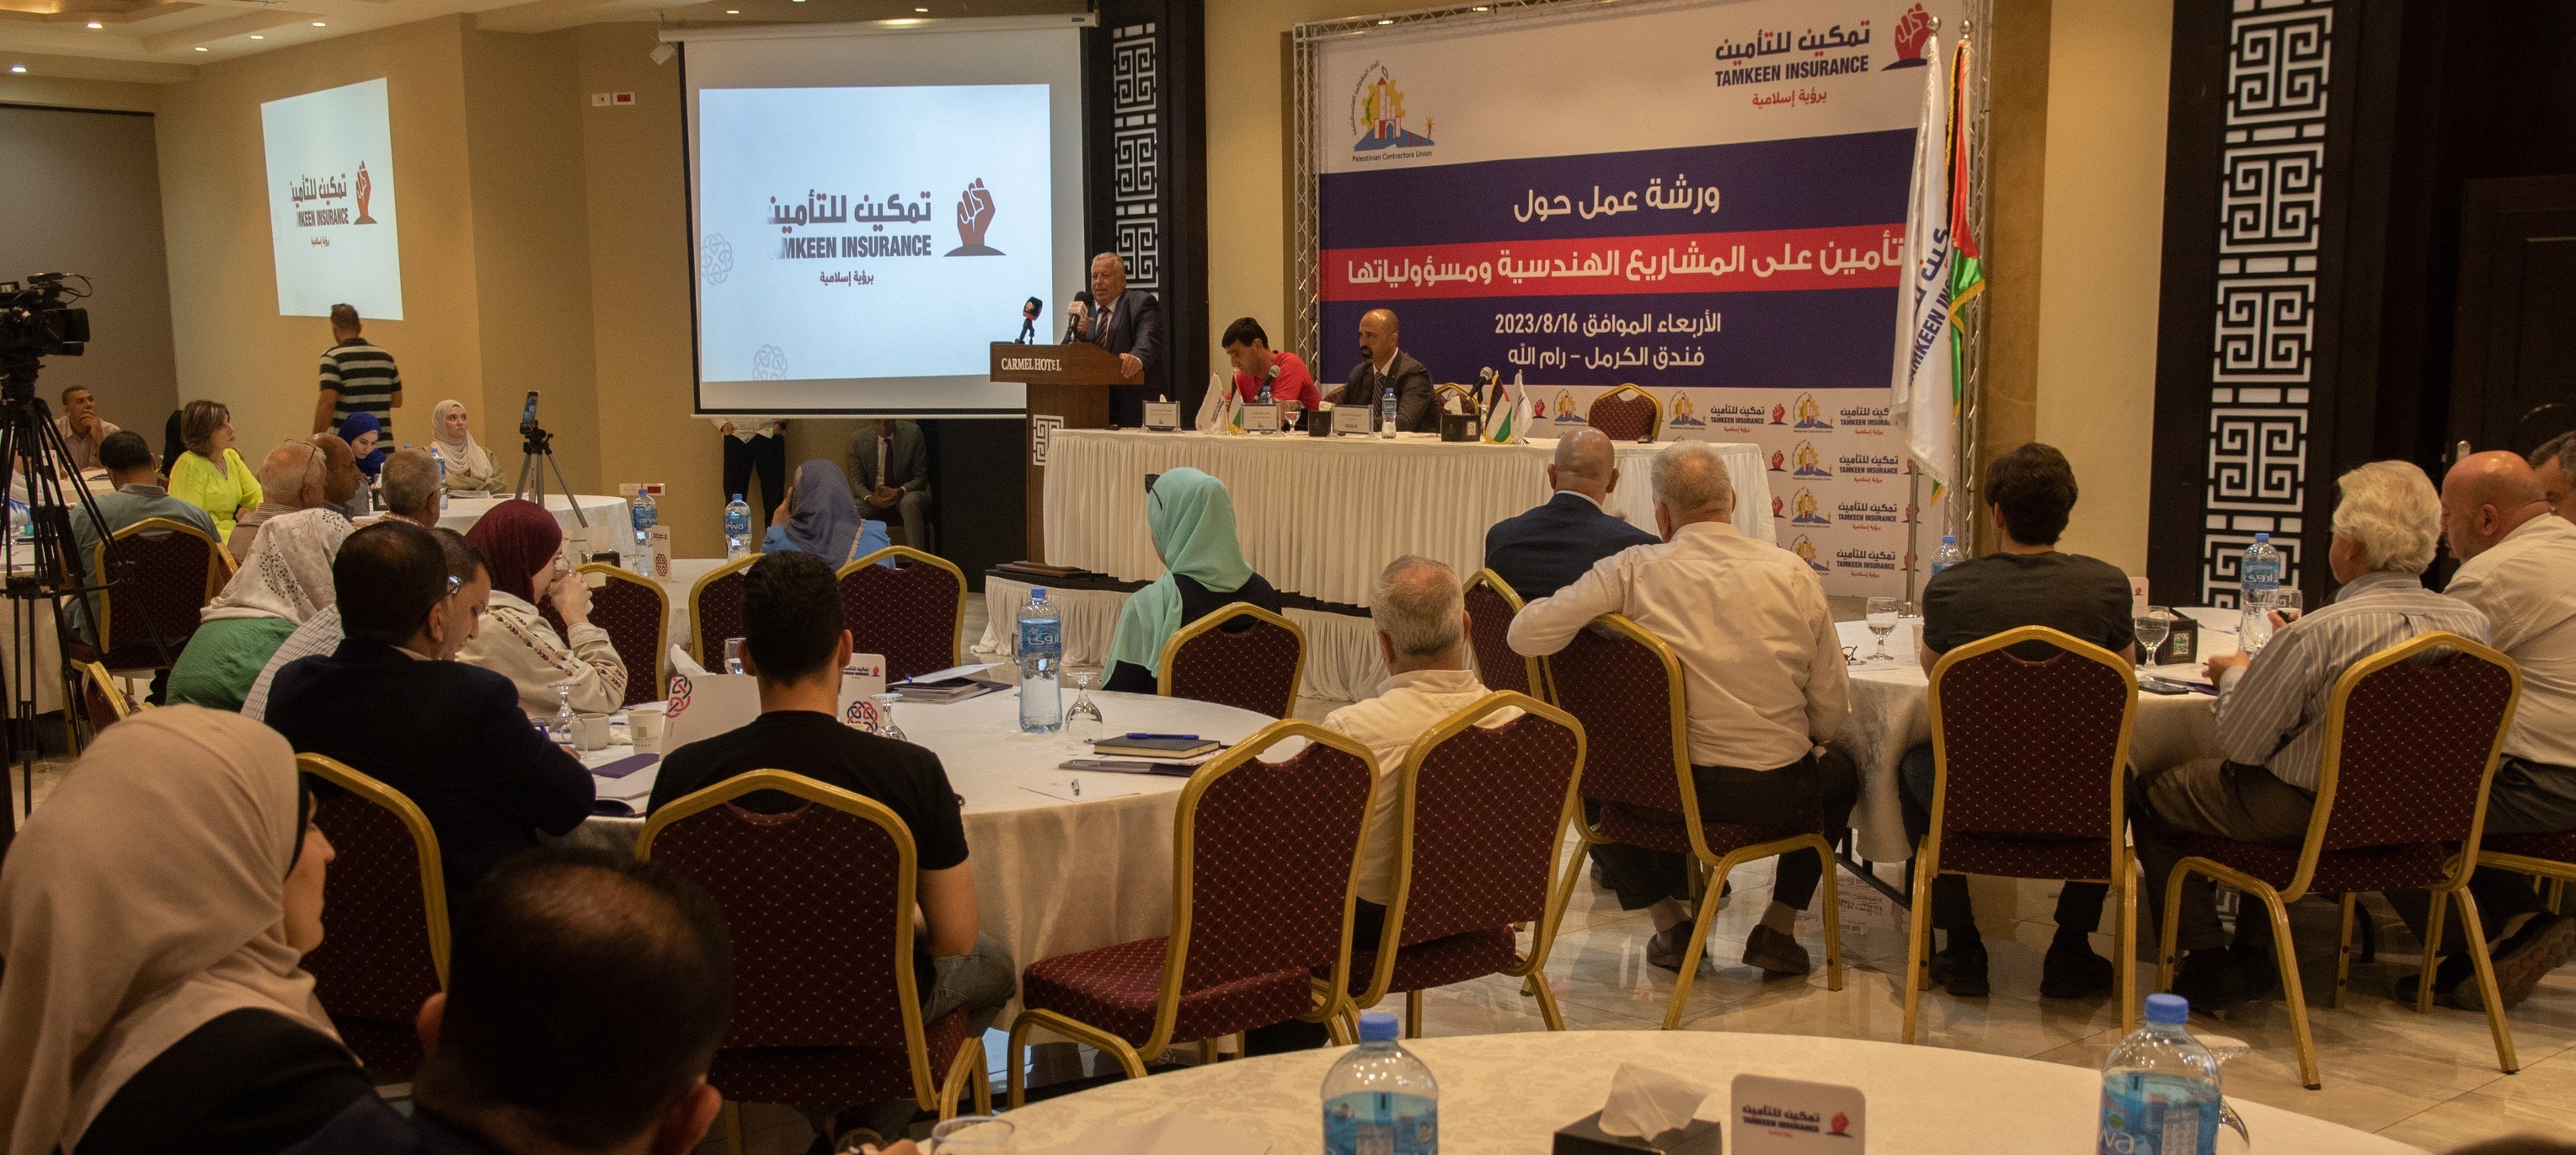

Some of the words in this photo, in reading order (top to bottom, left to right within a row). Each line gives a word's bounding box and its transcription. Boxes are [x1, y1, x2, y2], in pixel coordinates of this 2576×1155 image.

[1715, 29, 1792, 66] للتأمين
[1798, 20, 1870, 56] تمكين
[1715, 64, 1781, 87] TAMKEEN
[1786, 55, 1869, 80] INSURANCE
[1752, 89, 1795, 109] إسلامية
[1798, 87, 1827, 104] برؤية
[319, 173, 347, 206] تمكين
[1645, 174, 1720, 214] ورشة
[854, 191, 931, 232] تمكين
[1514, 190, 1571, 222] حول
[1579, 185, 1638, 220] عمل
[316, 207, 349, 226] INSURANCE
[781, 237, 836, 259] MKEEN
[842, 235, 932, 258] INSURANCE
[1348, 255, 1492, 288] ومسؤولياتها
[1497, 249, 1620, 284] الهندسية
[1626, 240, 1745, 281] المشاريع
[1751, 243, 1812, 278] على
[820, 271, 851, 286] إسلامية
[853, 270, 874, 285] برؤية
[1495, 313, 1578, 334] 2023/8/16
[1582, 313, 1652, 337] الموافق
[1657, 309, 1721, 338] الأربعاء
[1001, 357, 1034, 371] CARMEL
[1034, 358, 1061, 372] HOTEL
[1508, 342, 1536, 365] الله
[1539, 346, 1566, 369] رام
[1585, 346, 1648, 370] الكرمل
[1653, 346, 1705, 370] فندق
[1710, 404, 1738, 416] للتأمين
[1740, 406, 1766, 417] تمكين
[1840, 405, 1870, 419] للتأمين
[1839, 453, 1869, 467] للتأمين
[1871, 455, 1899, 467] تمكين
[1838, 500, 1868, 514] للتأمين
[1865, 514, 1897, 522] INSURANCE
[1870, 503, 1897, 515] تمكين
[1836, 548, 1867, 560] للتأمين
[1868, 550, 1895, 562] تمكين
[1863, 562, 1895, 570] INSURANCE
